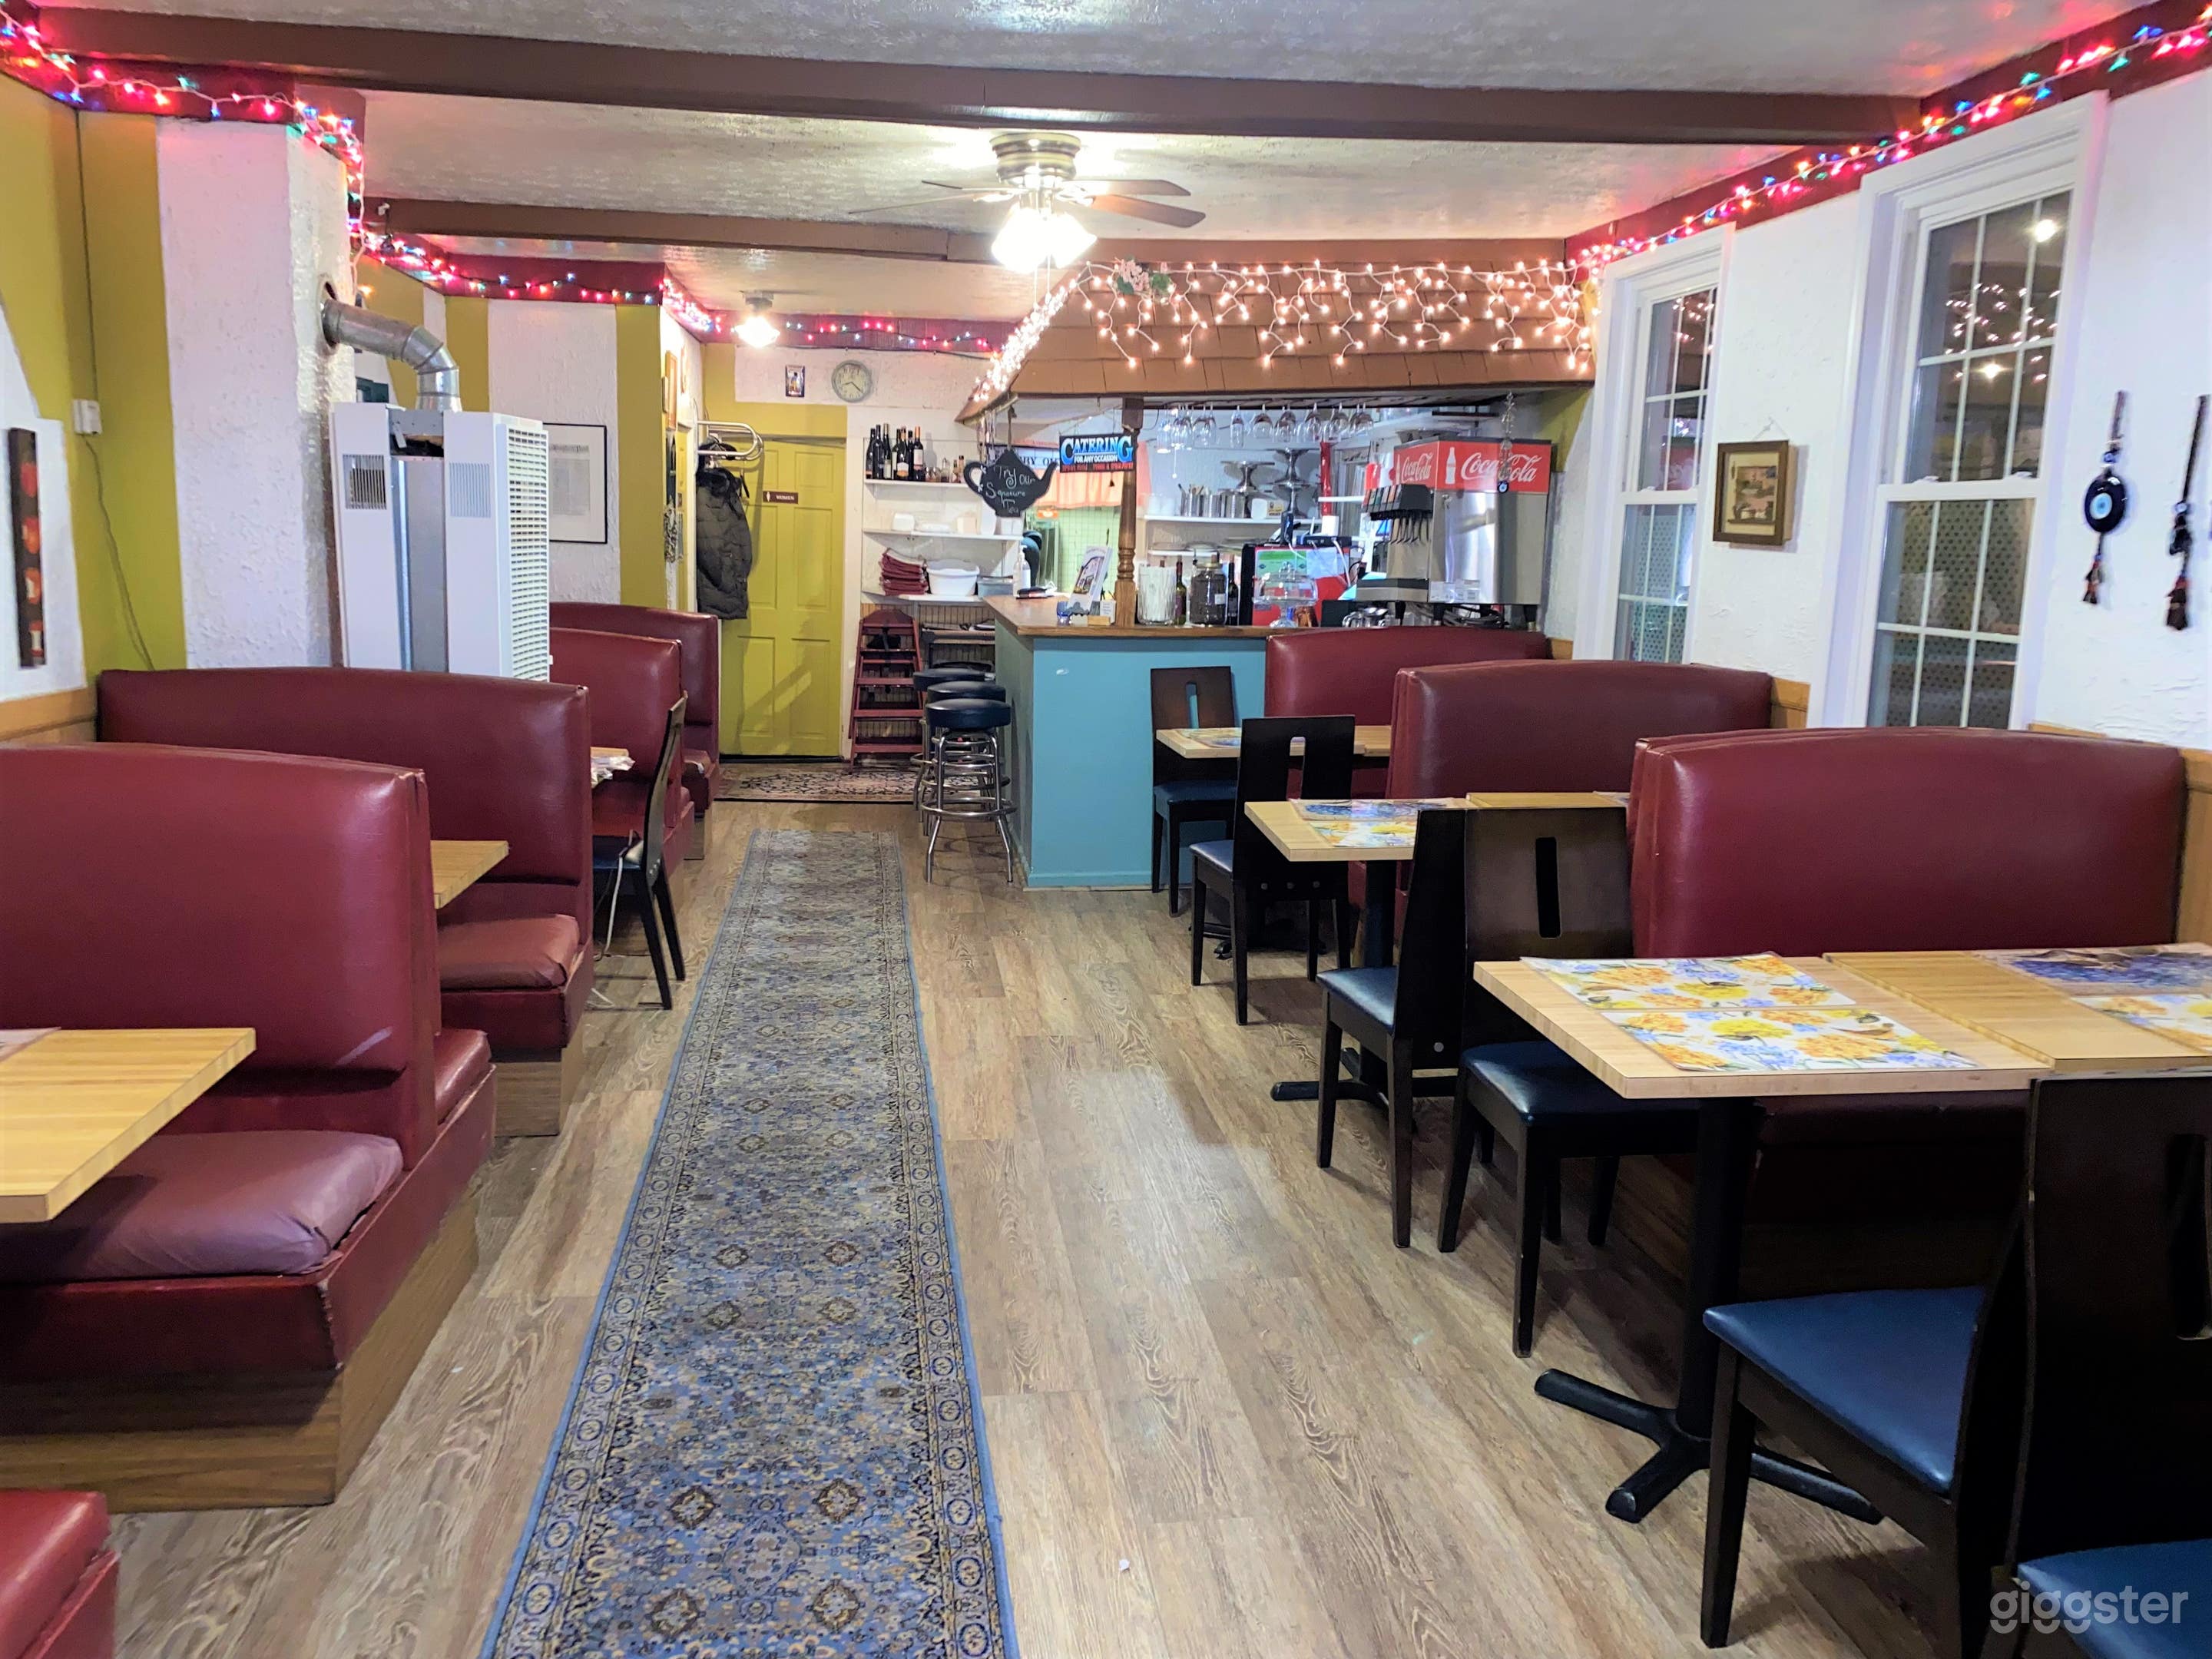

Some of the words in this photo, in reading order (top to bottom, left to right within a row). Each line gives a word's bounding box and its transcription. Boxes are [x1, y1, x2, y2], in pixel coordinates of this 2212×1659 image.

[1061, 435, 1133, 465] CATERING
[1094, 454, 1118, 462] OCCASION
[994, 465, 1017, 489] Try
[1019, 474, 1035, 485] Our
